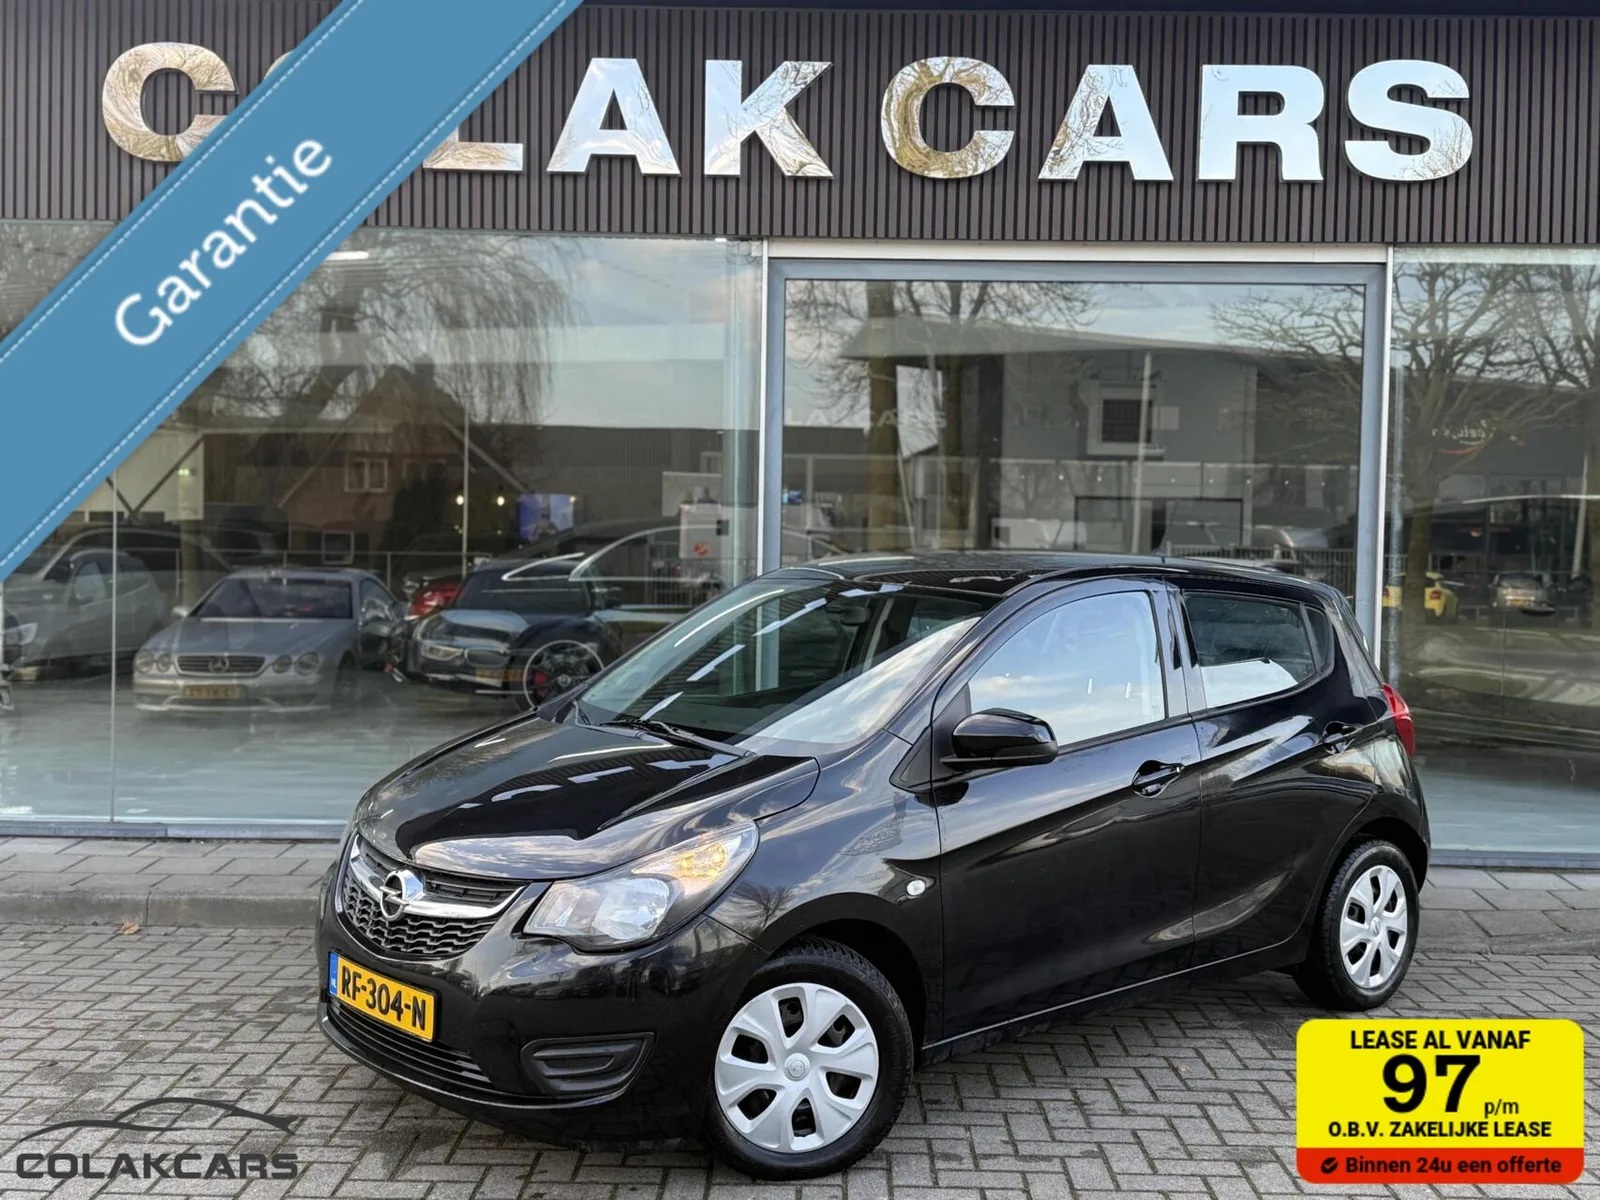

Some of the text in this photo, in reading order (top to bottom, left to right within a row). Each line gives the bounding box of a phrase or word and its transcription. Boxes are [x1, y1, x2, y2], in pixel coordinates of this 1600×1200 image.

[102, 41, 1474, 182] CAK CARS
[341, 965, 426, 1031] RF-304-N
